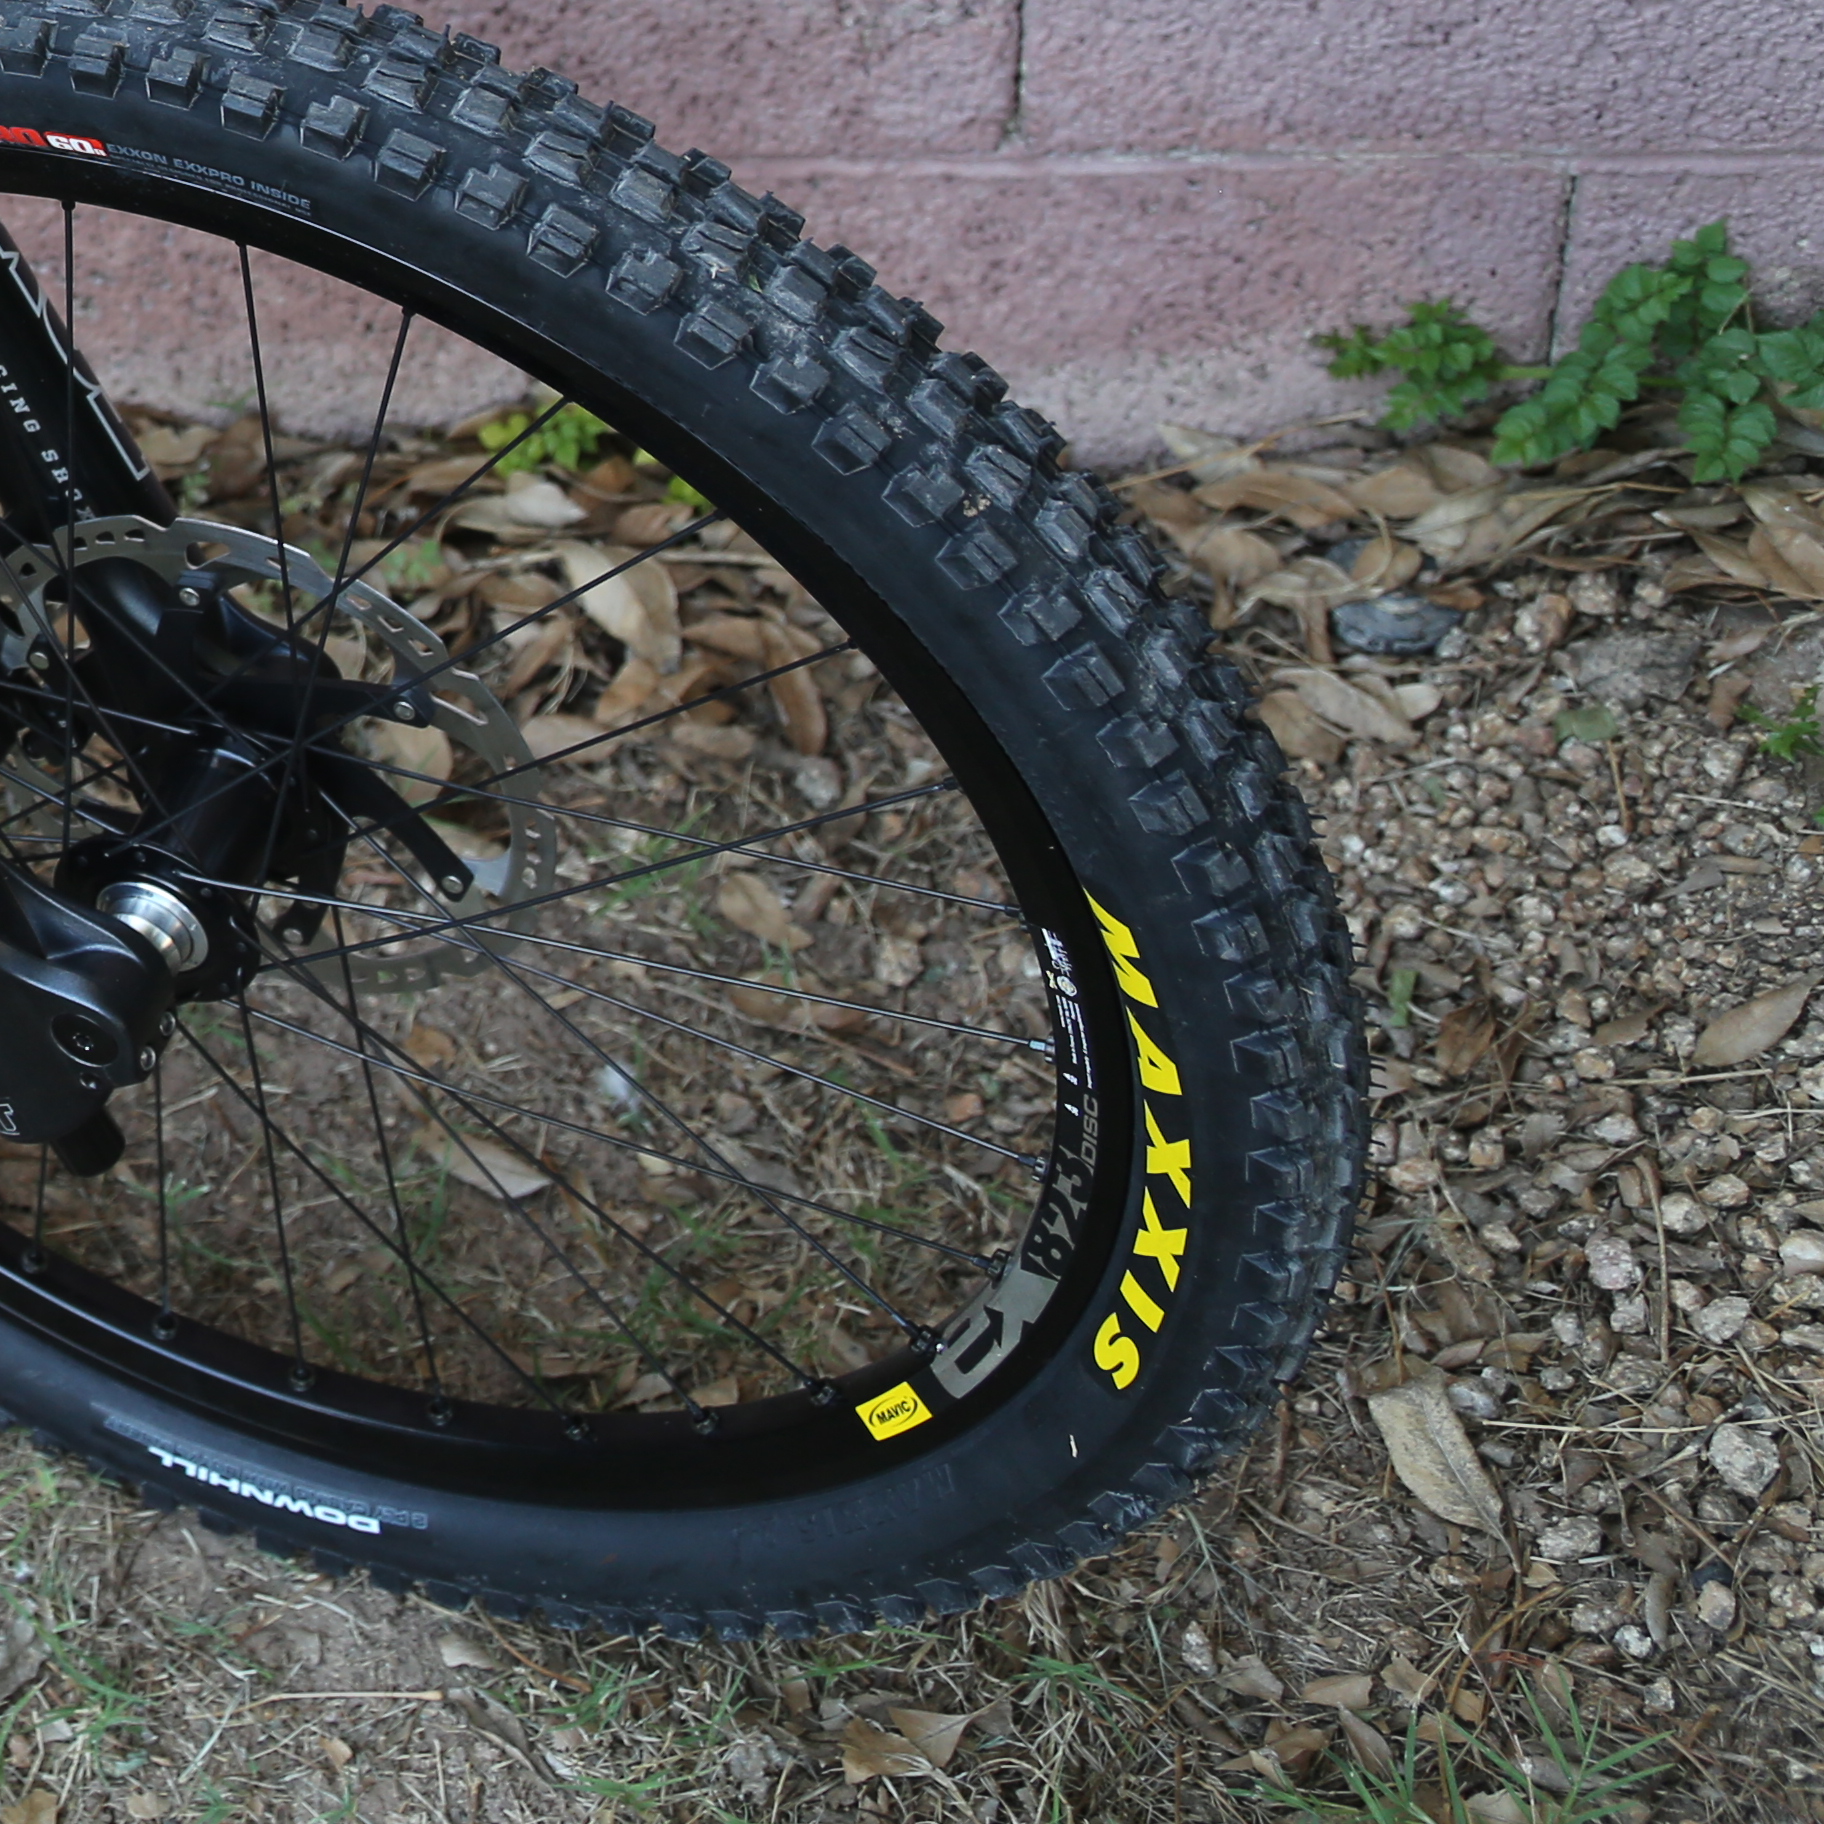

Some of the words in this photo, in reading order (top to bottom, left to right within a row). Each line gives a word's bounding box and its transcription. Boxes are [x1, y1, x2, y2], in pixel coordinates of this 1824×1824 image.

[105, 142, 168, 165] EXXON
[172, 157, 246, 187] EXXPRO
[250, 180, 312, 210] INSIDE
[1080, 1093, 1099, 1166] DISC
[1083, 886, 1192, 1390] MAXXIS
[875, 1397, 912, 1427] MAVIC
[148, 1444, 382, 1535] DOWNHILL
